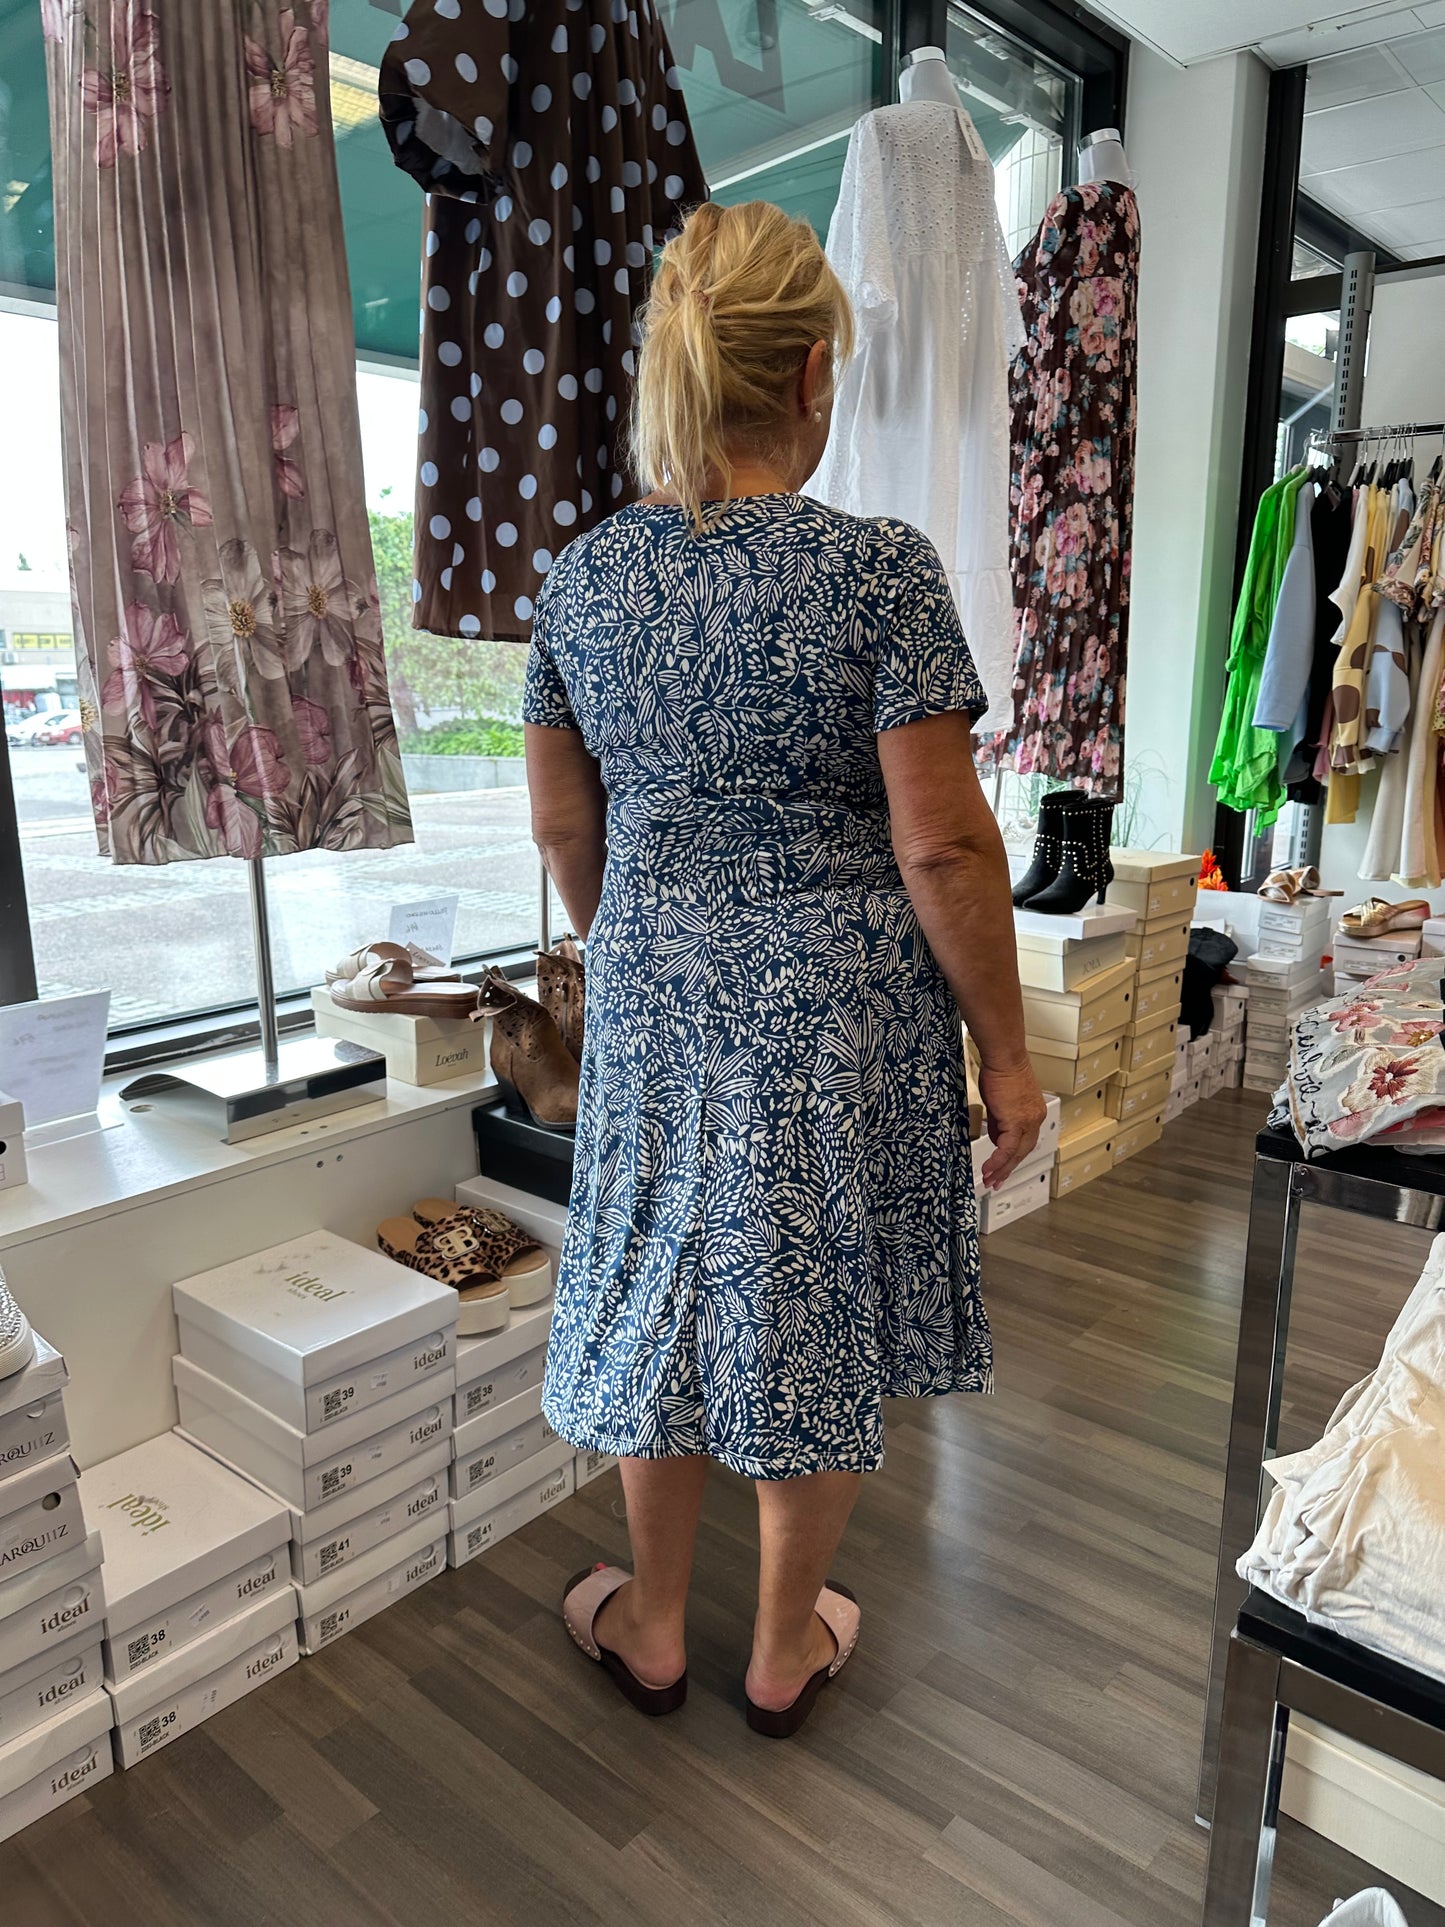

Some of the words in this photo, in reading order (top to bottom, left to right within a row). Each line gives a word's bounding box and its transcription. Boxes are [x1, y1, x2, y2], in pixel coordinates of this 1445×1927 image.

[285, 1271, 348, 1302] ideal
[413, 1344, 446, 1370] ideal
[342, 1387, 355, 1401] 39
[482, 1384, 493, 1397] 38
[410, 1419, 442, 1445] ideal
[340, 1464, 352, 1479] 39
[483, 1456, 495, 1469] 40
[407, 1489, 439, 1516] ideal
[540, 1478, 567, 1504] ideal
[106, 1493, 171, 1537] ideal
[481, 1523, 492, 1536] 41
[0, 1524, 70, 1567] ARQUIIZ
[338, 1538, 350, 1552] 41
[406, 1555, 438, 1583] ideal
[238, 1568, 277, 1599] ideal
[40, 1597, 90, 1635] ideal
[338, 1609, 350, 1623] 41
[151, 1629, 166, 1646] 38
[247, 1647, 285, 1680] ideal
[38, 1671, 86, 1708] ideal
[161, 1711, 177, 1728] 38
[51, 1756, 98, 1795] ideal
